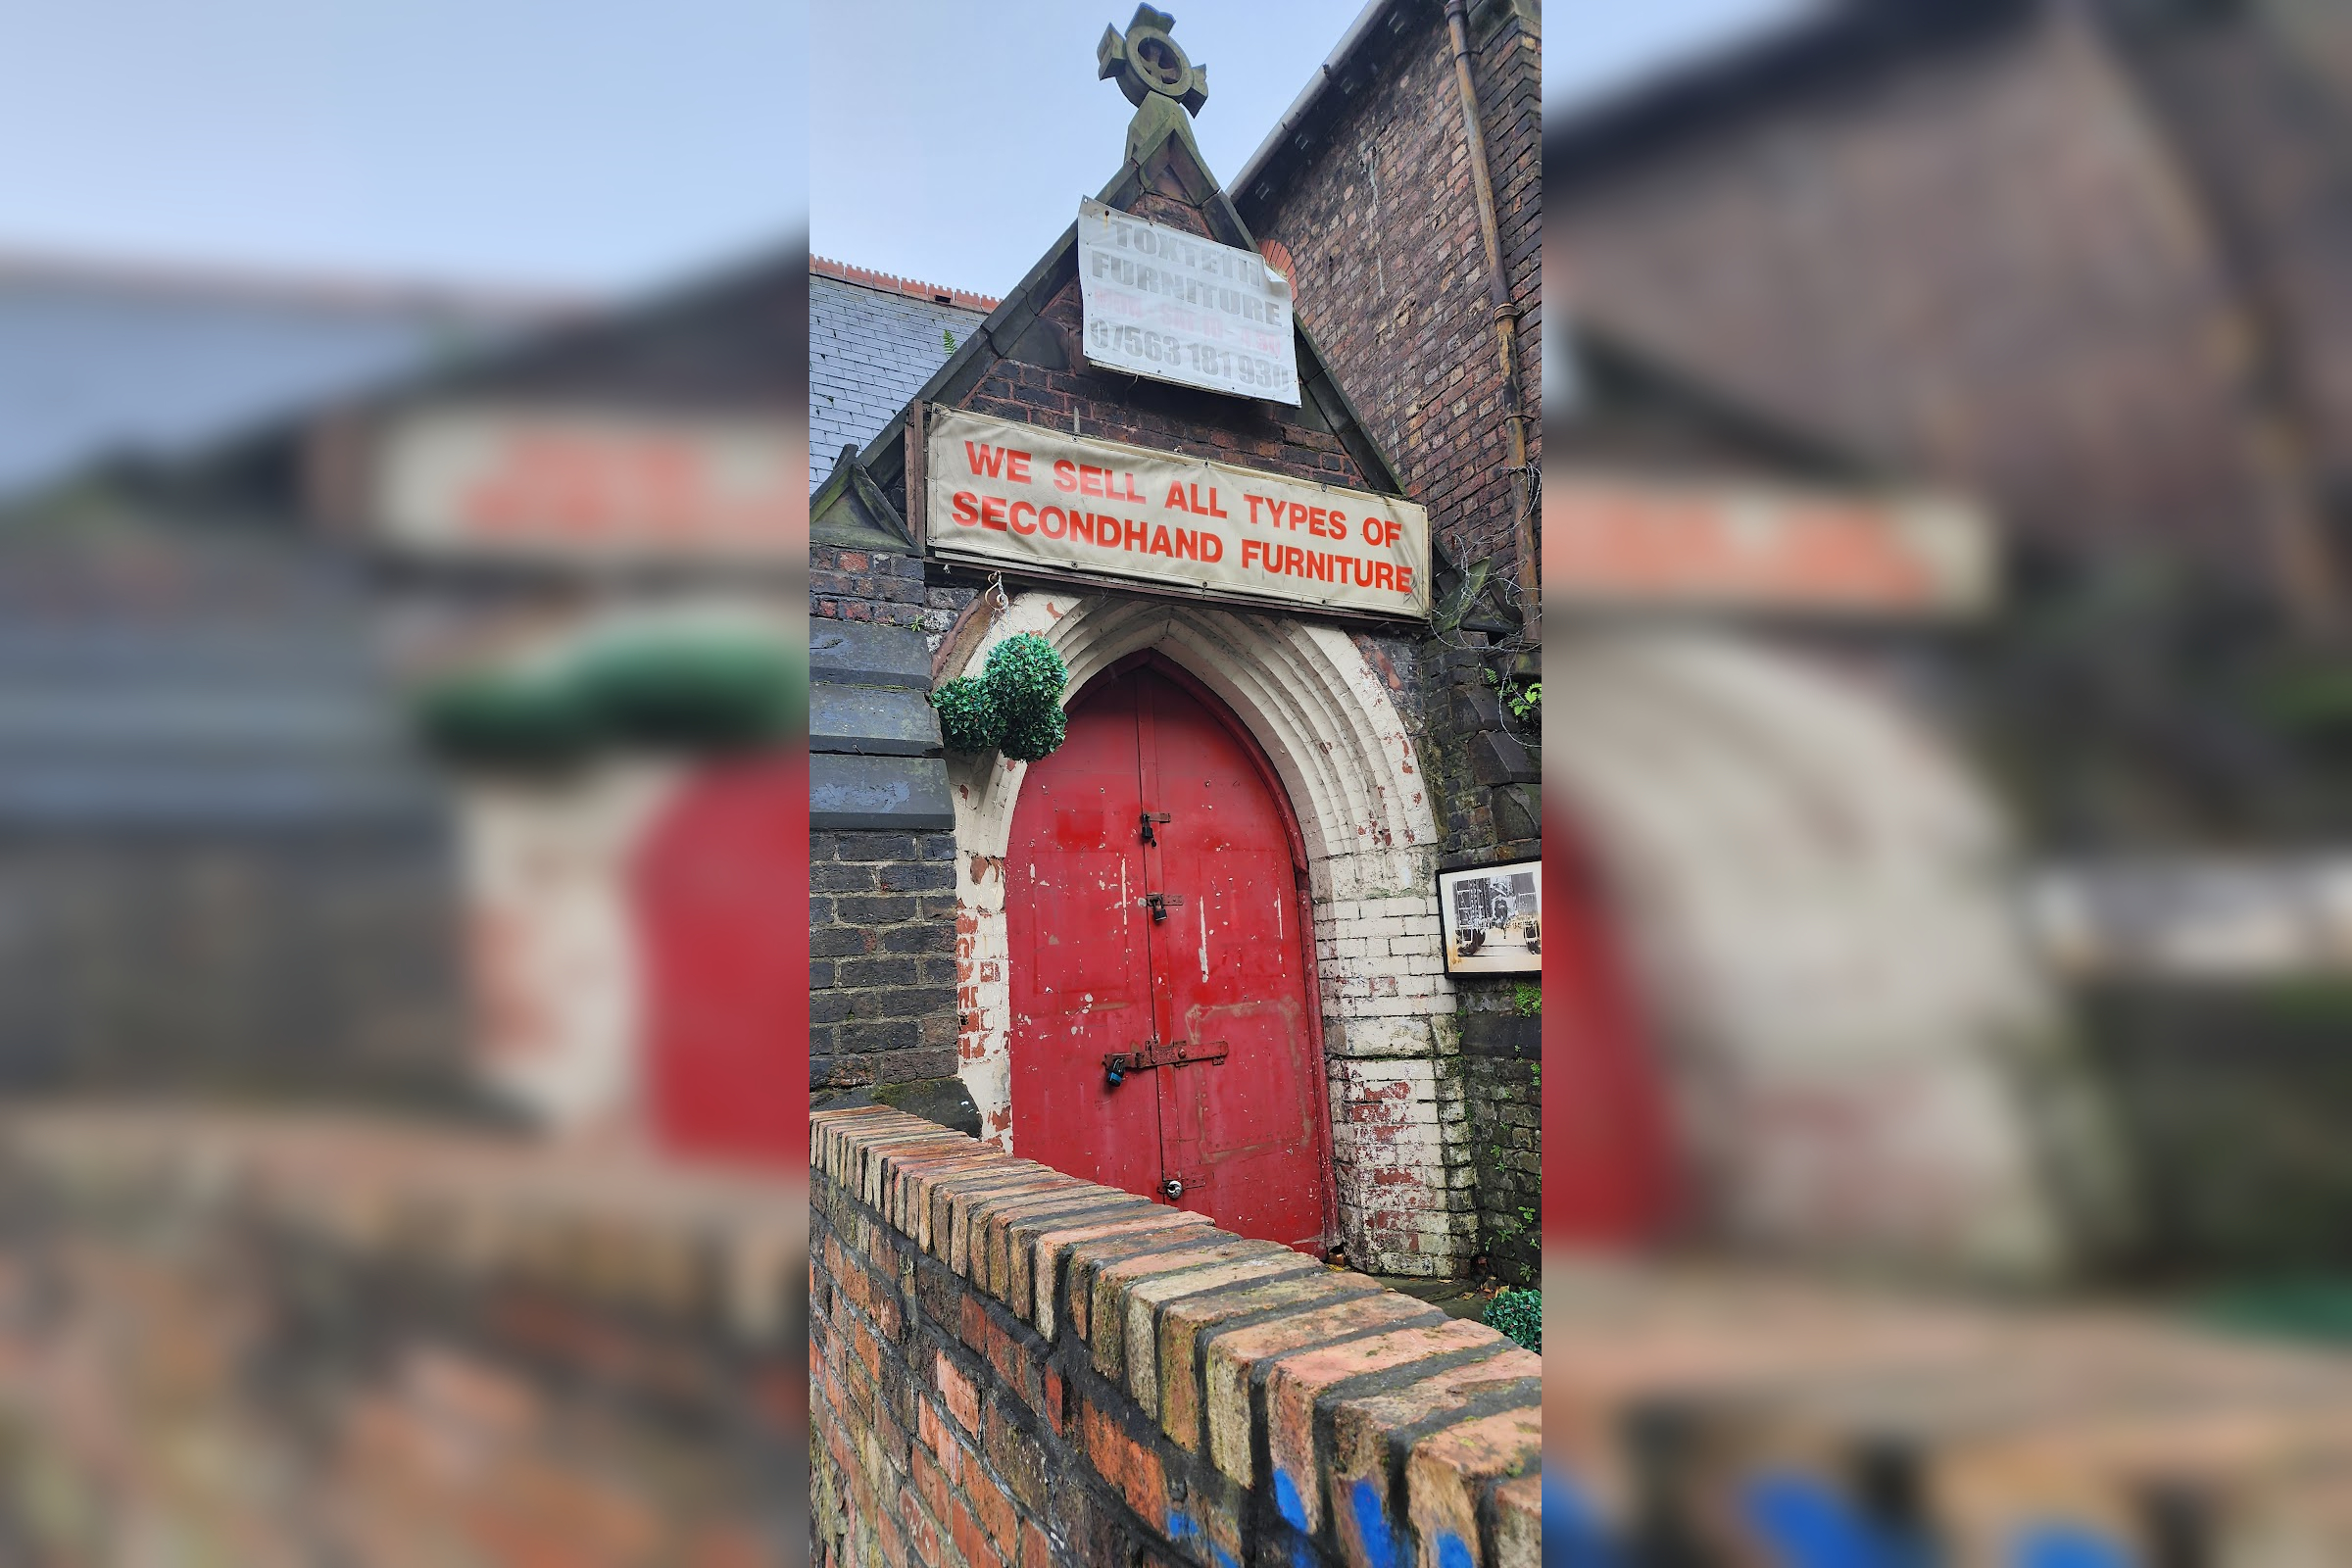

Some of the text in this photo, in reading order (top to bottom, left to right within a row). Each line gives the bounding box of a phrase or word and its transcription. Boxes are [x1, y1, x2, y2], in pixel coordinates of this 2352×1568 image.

[1091, 250, 1283, 327] FURNITURE
[1110, 220, 1260, 287] TOXTETH
[1090, 317, 1290, 392] 07563 181 930
[965, 441, 1402, 548] WE SELL ALL TYPES OF
[952, 491, 1413, 594] SECONDHAND FURNITURE
